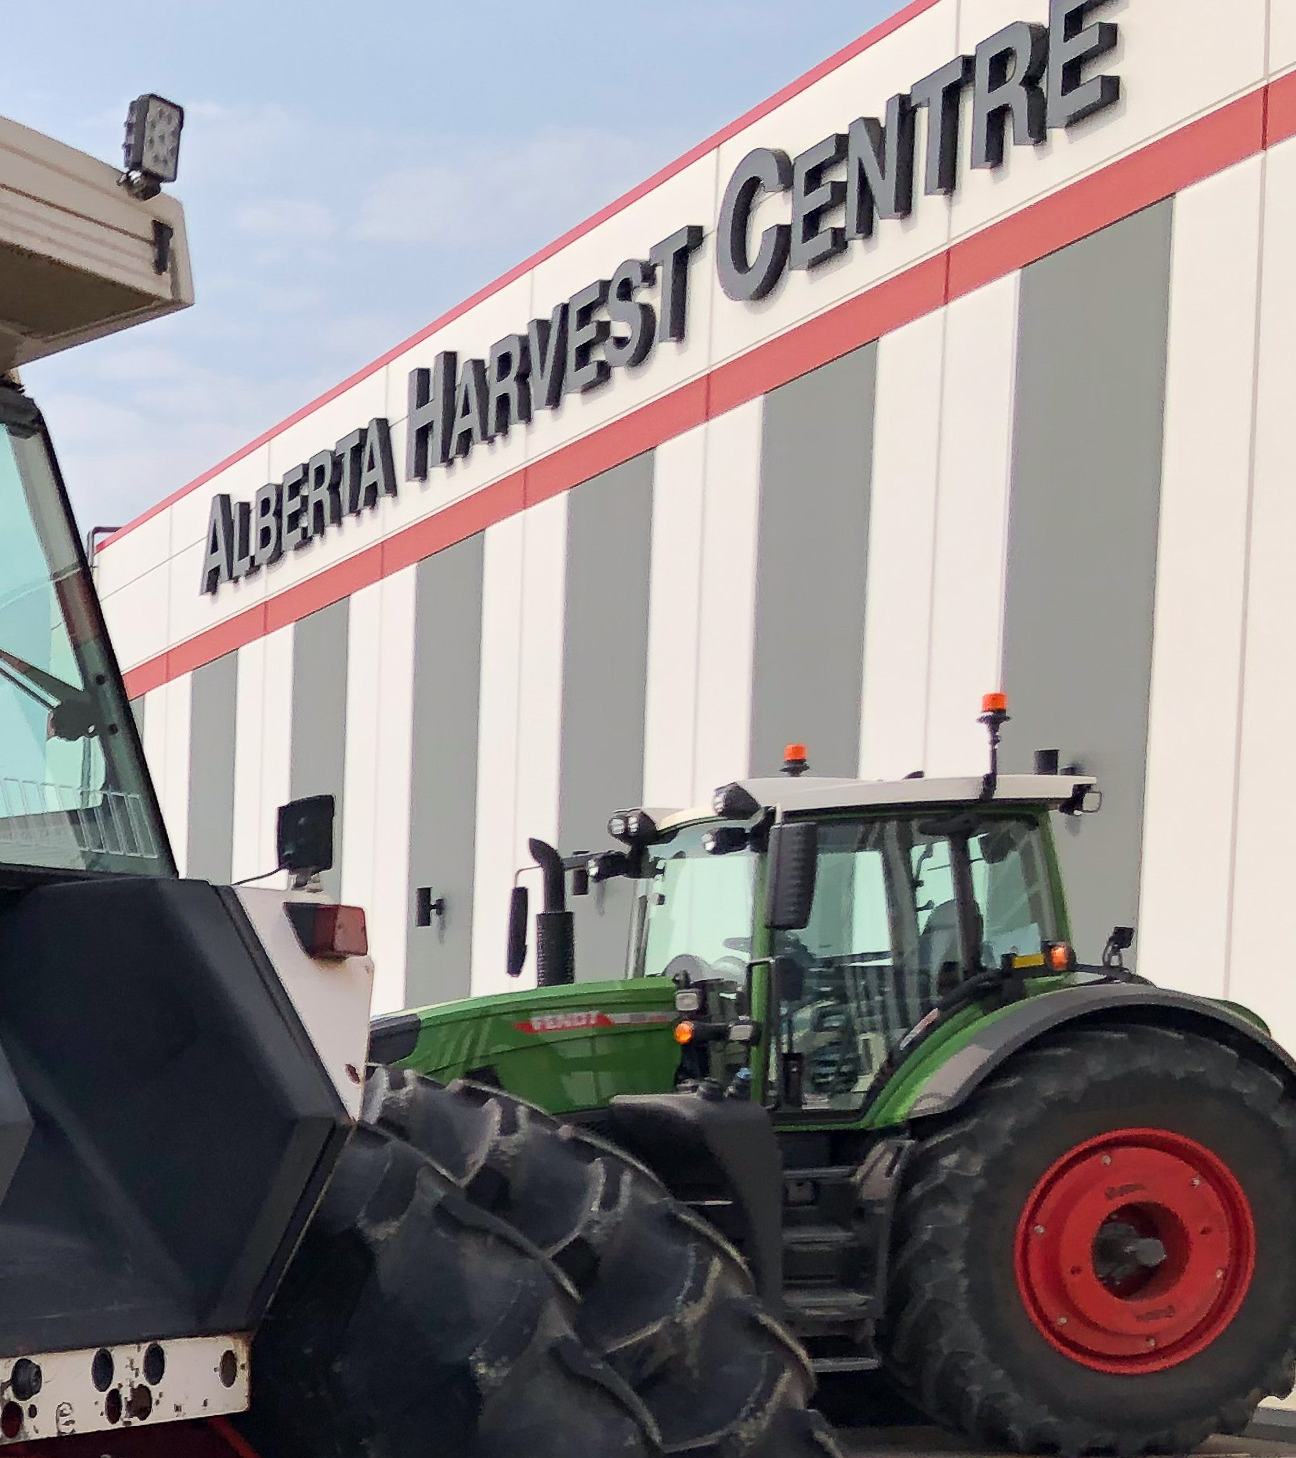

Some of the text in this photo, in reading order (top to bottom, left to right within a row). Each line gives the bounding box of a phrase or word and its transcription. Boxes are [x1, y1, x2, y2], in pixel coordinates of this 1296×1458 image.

[200, 0, 1121, 595] ALBERTA HARVEST CENTRE
